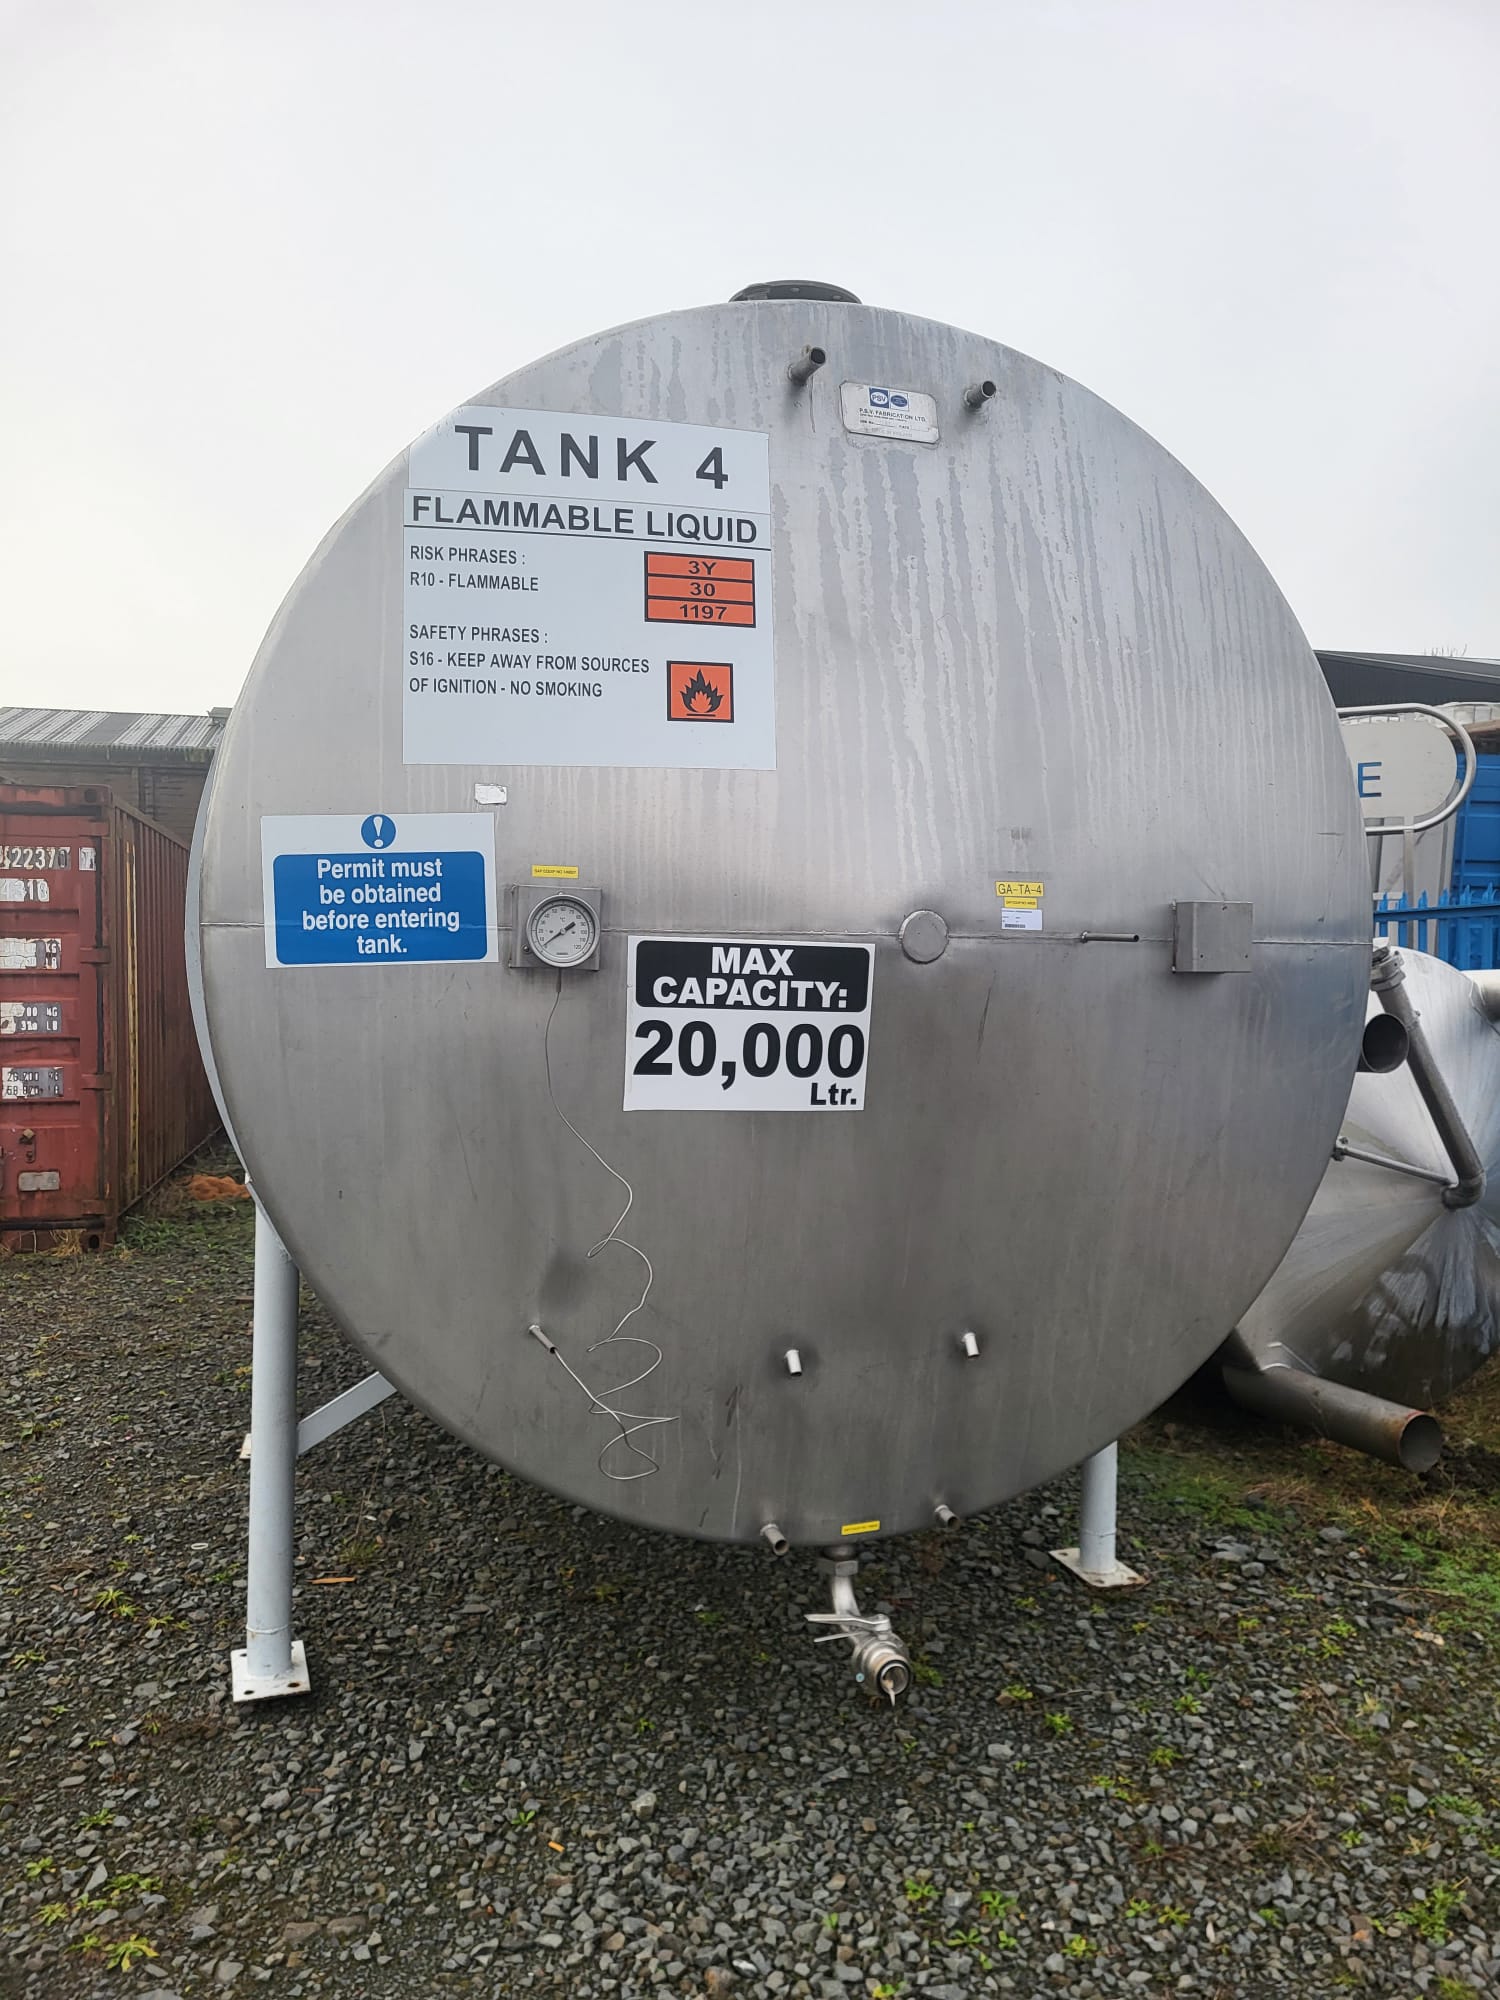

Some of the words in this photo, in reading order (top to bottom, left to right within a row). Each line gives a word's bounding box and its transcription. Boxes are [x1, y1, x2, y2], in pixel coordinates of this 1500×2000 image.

[454, 424, 659, 484] TANK
[695, 446, 729, 490] 4
[413, 495, 634, 534] FLAMMABLE
[647, 511, 757, 544] LIQUID
[410, 545, 444, 561] RISK
[448, 547, 517, 564] PHRASES
[688, 560, 717, 575] 3Y
[410, 571, 435, 586] R10
[448, 573, 539, 591] FLAMMABLE
[689, 582, 716, 597] 30
[679, 604, 728, 620] 1197
[409, 624, 467, 640] SAFETY
[471, 626, 540, 643] PHRASES
[409, 651, 434, 666] S16
[447, 652, 486, 667] KEEP
[490, 654, 532, 669] AWAY
[536, 655, 577, 671] FROM
[581, 657, 650, 673] SOURCES
[409, 677, 429, 692] OF
[433, 678, 497, 694] IGNITION
[510, 681, 531, 695] NO
[535, 681, 602, 698] SMOKING
[317, 858, 385, 879] Permit
[391, 858, 443, 878] must
[319, 884, 346, 905] be
[351, 882, 441, 904] obtained
[998, 883, 1042, 895] GA-TA-4
[302, 909, 369, 931] before
[375, 908, 460, 932] entering
[356, 933, 408, 955] tank.
[711, 946, 794, 976] MAX
[652, 976, 848, 1009] CAPACITY:
[632, 1019, 865, 1091] 20,000
[810, 1082, 858, 1106] Ltr.
